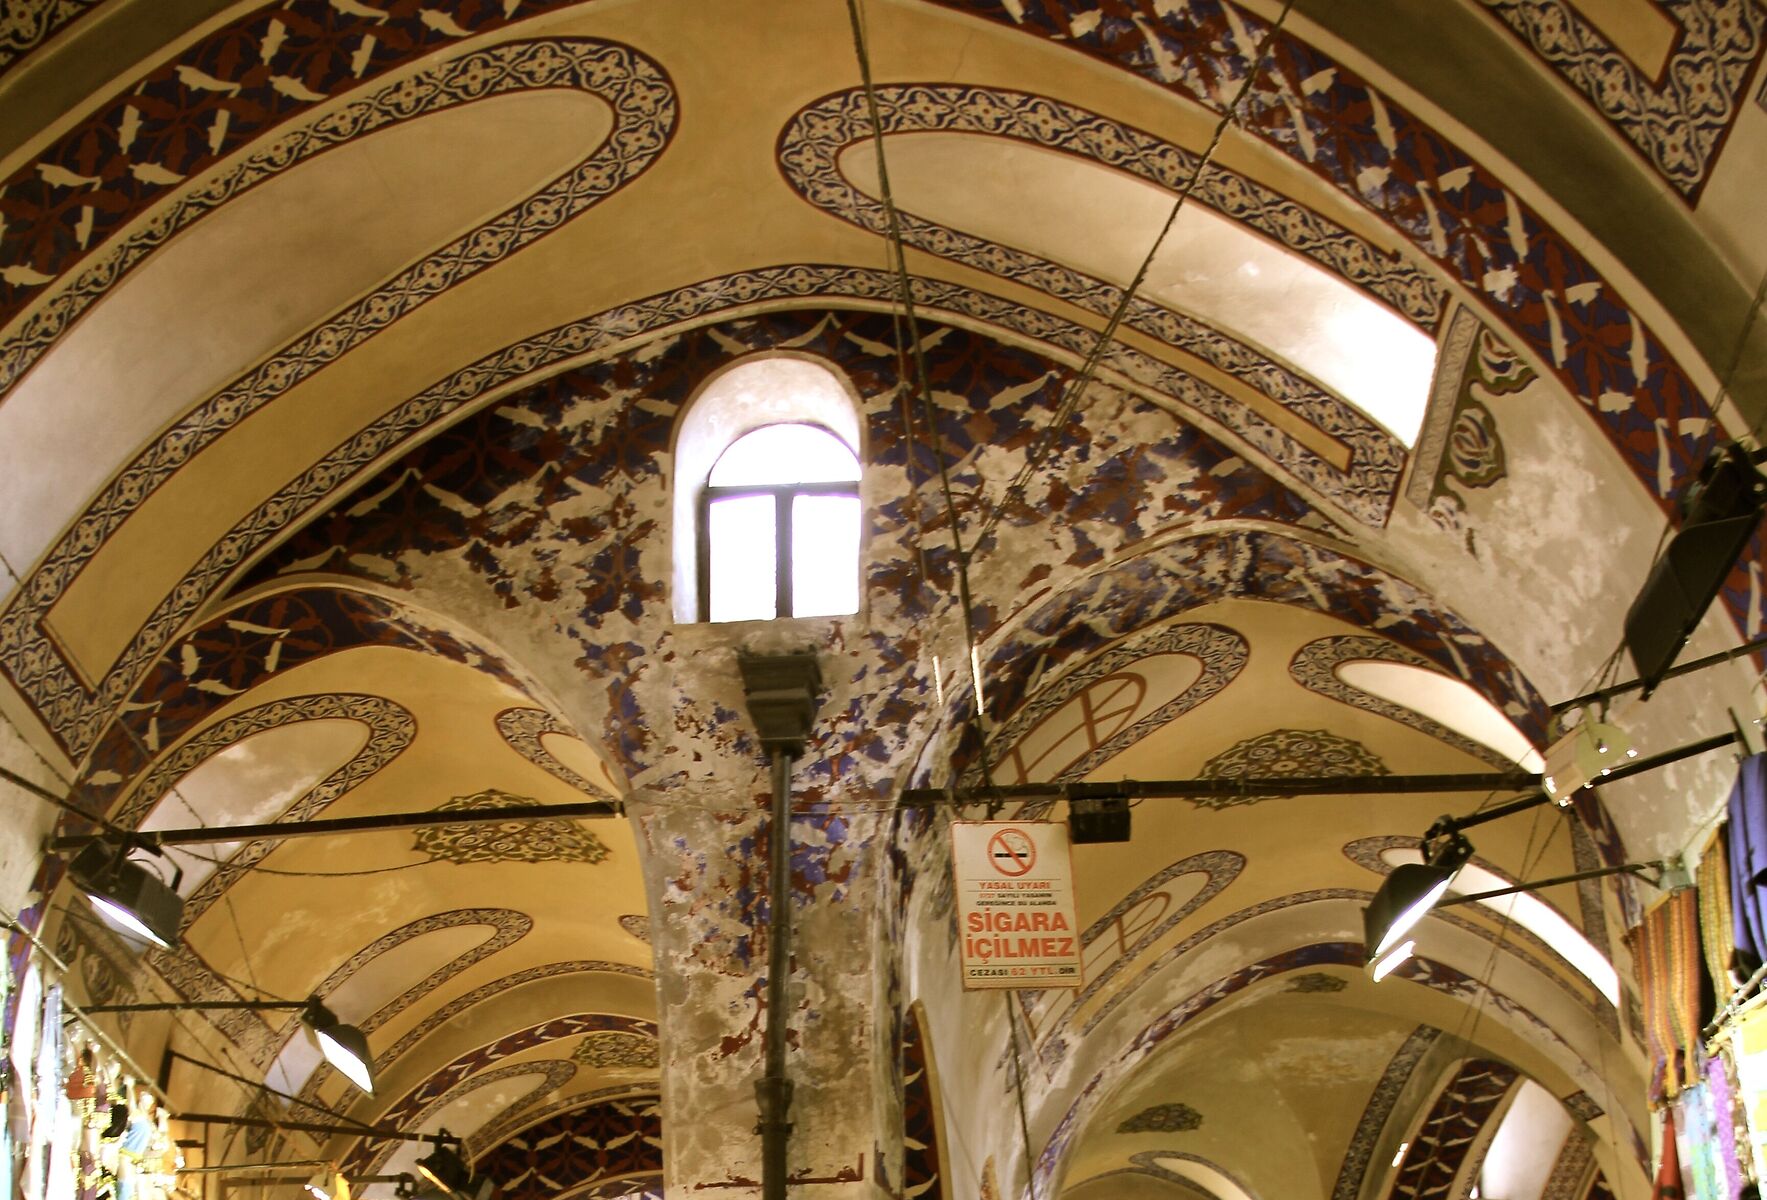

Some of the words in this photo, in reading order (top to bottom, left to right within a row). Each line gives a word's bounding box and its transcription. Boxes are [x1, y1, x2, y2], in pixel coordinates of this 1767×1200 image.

[979, 881, 1014, 889] YASAL
[1017, 881, 1051, 889] UYARI
[967, 907, 1069, 932] SİGARA
[966, 933, 1075, 964] İÇİLMEZ
